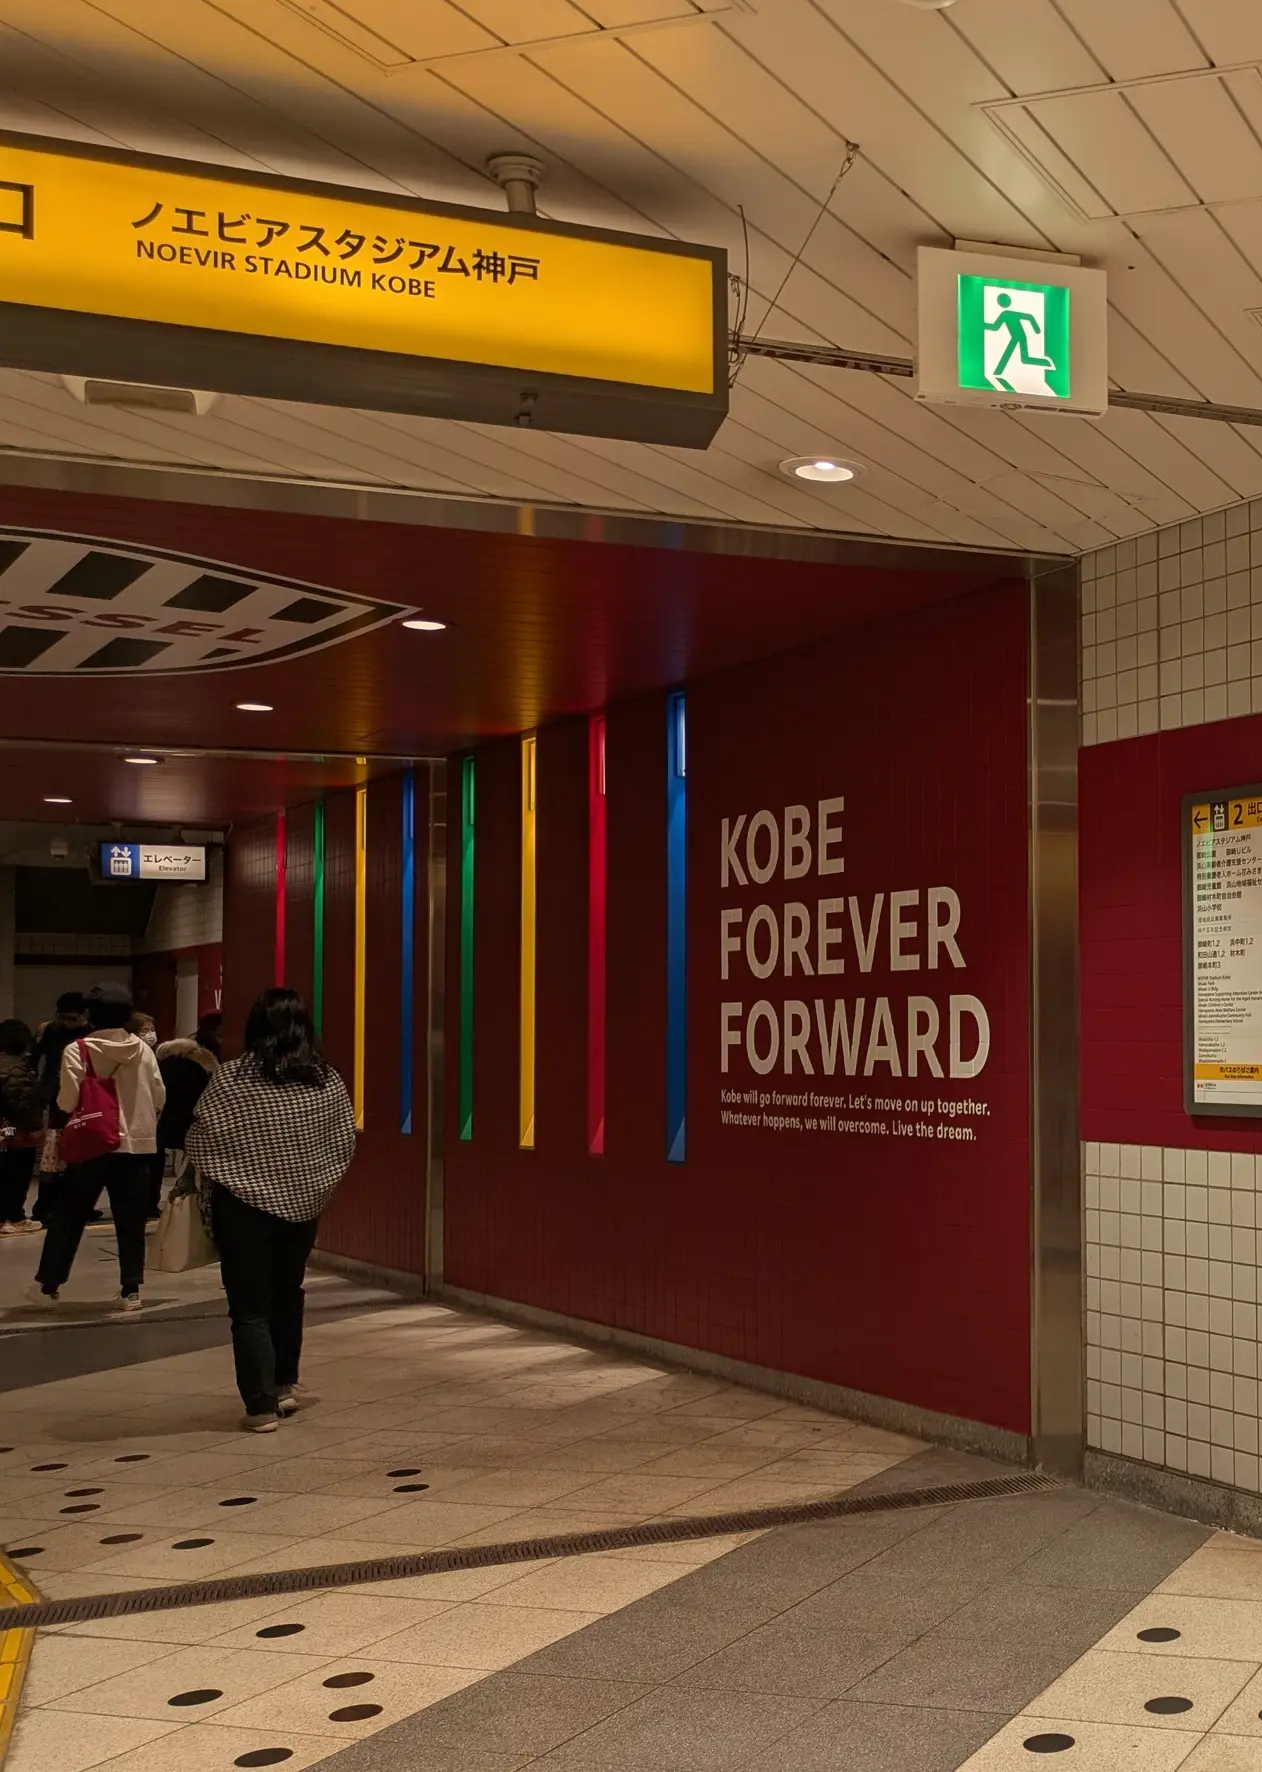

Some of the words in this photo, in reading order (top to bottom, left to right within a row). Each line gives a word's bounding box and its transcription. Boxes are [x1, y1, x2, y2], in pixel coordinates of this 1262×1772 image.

[131, 203, 540, 285] ノエビアスタジアム神戸
[136, 239, 236, 271] NOEVIR
[245, 254, 362, 287] STADIUM
[371, 271, 436, 298] KOBE
[0, 601, 266, 644] SSEL
[1234, 804, 1243, 825] 2
[143, 854, 201, 864] エレベーター
[721, 796, 844, 888] KOBE
[721, 886, 966, 980] FOREVER
[721, 994, 990, 1079] FORWARD
[721, 1089, 742, 1104] Kobe
[743, 1091, 758, 1104] will
[759, 1094, 771, 1107] go
[772, 1092, 808, 1107] forward
[809, 1092, 846, 1108] forever.
[849, 1094, 872, 1110] Let's
[874, 1098, 902, 1111] move
[905, 1100, 918, 1112] on
[921, 1100, 935, 1116] up
[937, 1098, 991, 1118] together.
[721, 1110, 761, 1127] Whatever
[763, 1112, 803, 1132] happens,
[805, 1117, 817, 1130] we
[819, 1115, 836, 1131] will
[838, 1120, 889, 1135] overcome.
[892, 1119, 914, 1137] Live
[915, 1121, 934, 1138] the
[936, 1123, 977, 1141] dream.
